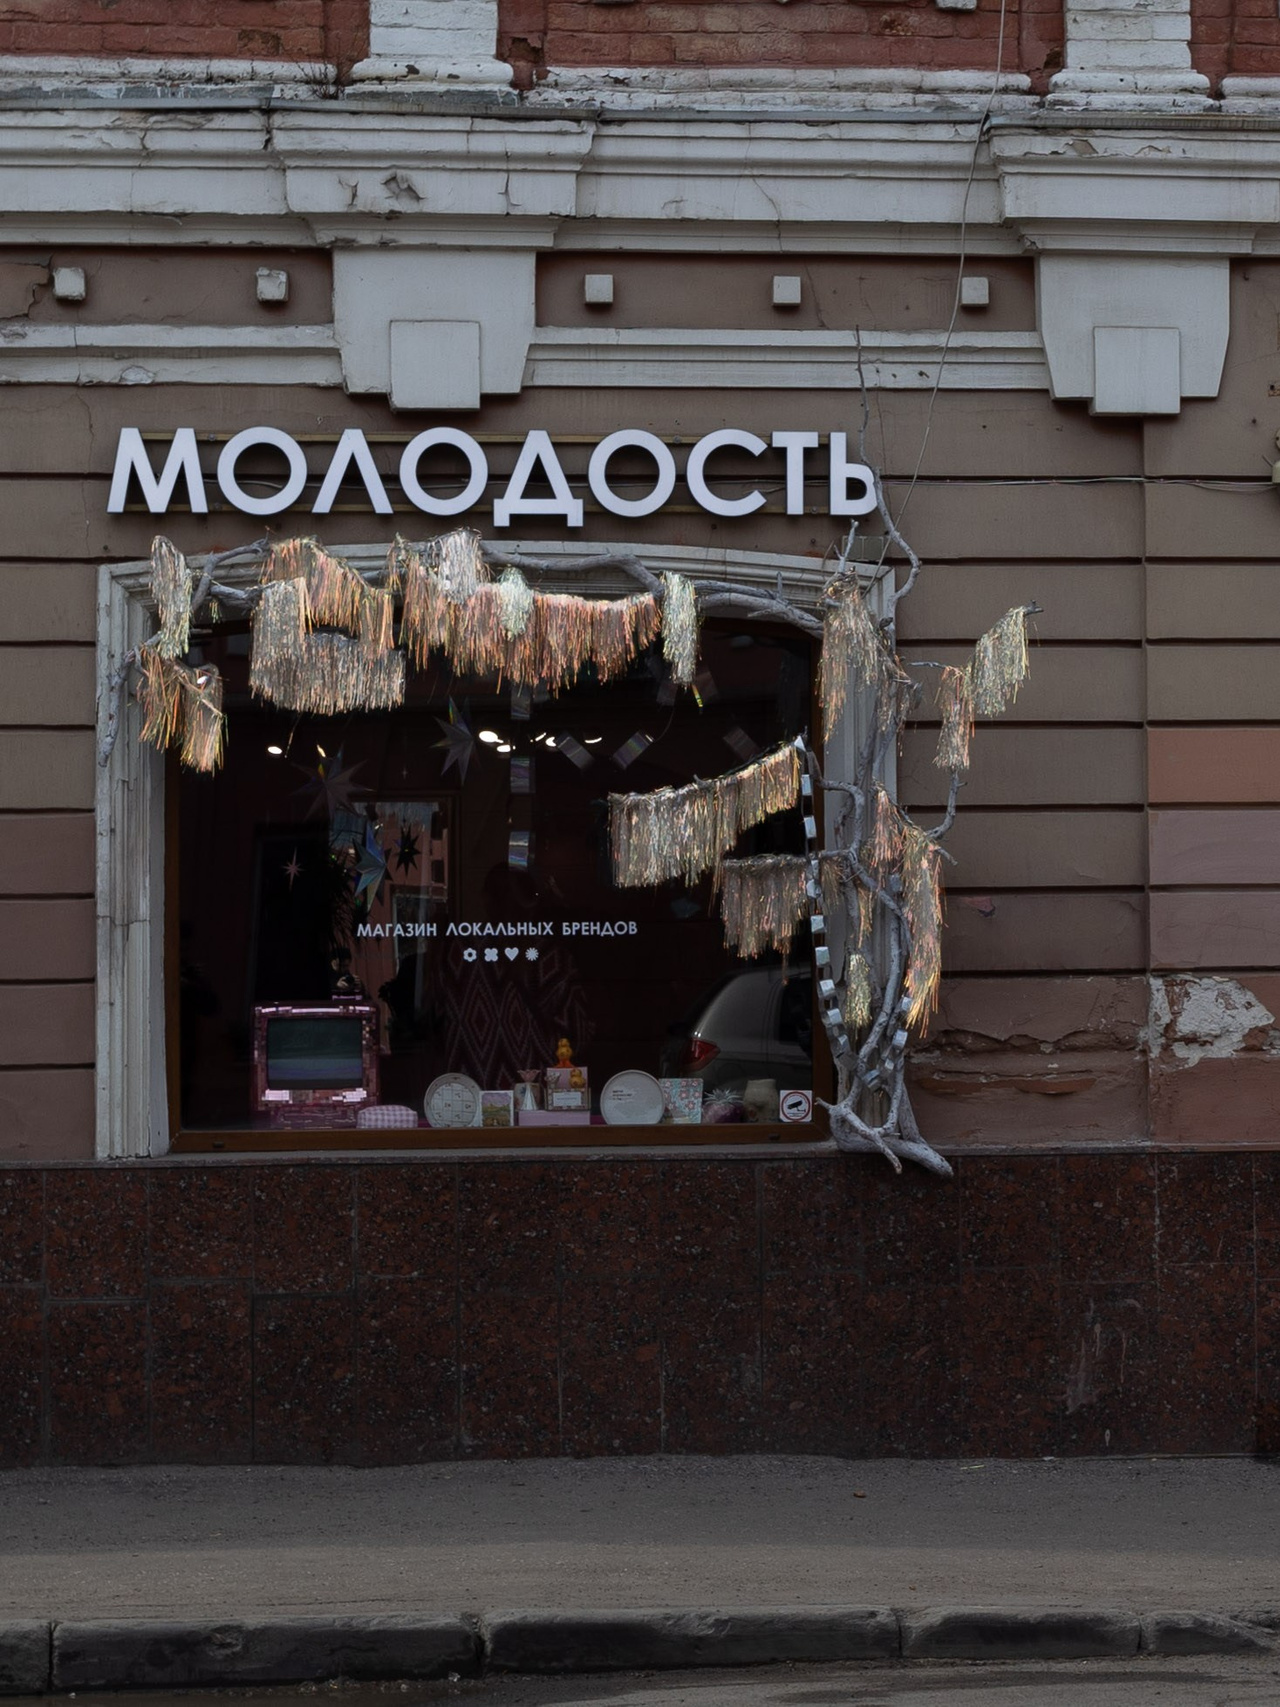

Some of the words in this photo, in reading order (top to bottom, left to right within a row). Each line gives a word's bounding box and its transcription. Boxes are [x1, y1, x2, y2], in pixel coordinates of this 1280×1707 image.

[106, 426, 879, 527] МОЛОДОСТЬ
[356, 922, 437, 938] МАГАЗИН
[445, 921, 554, 937] ЛОКАЛЬНЫХ
[562, 921, 638, 938] БРЕНДОВ
